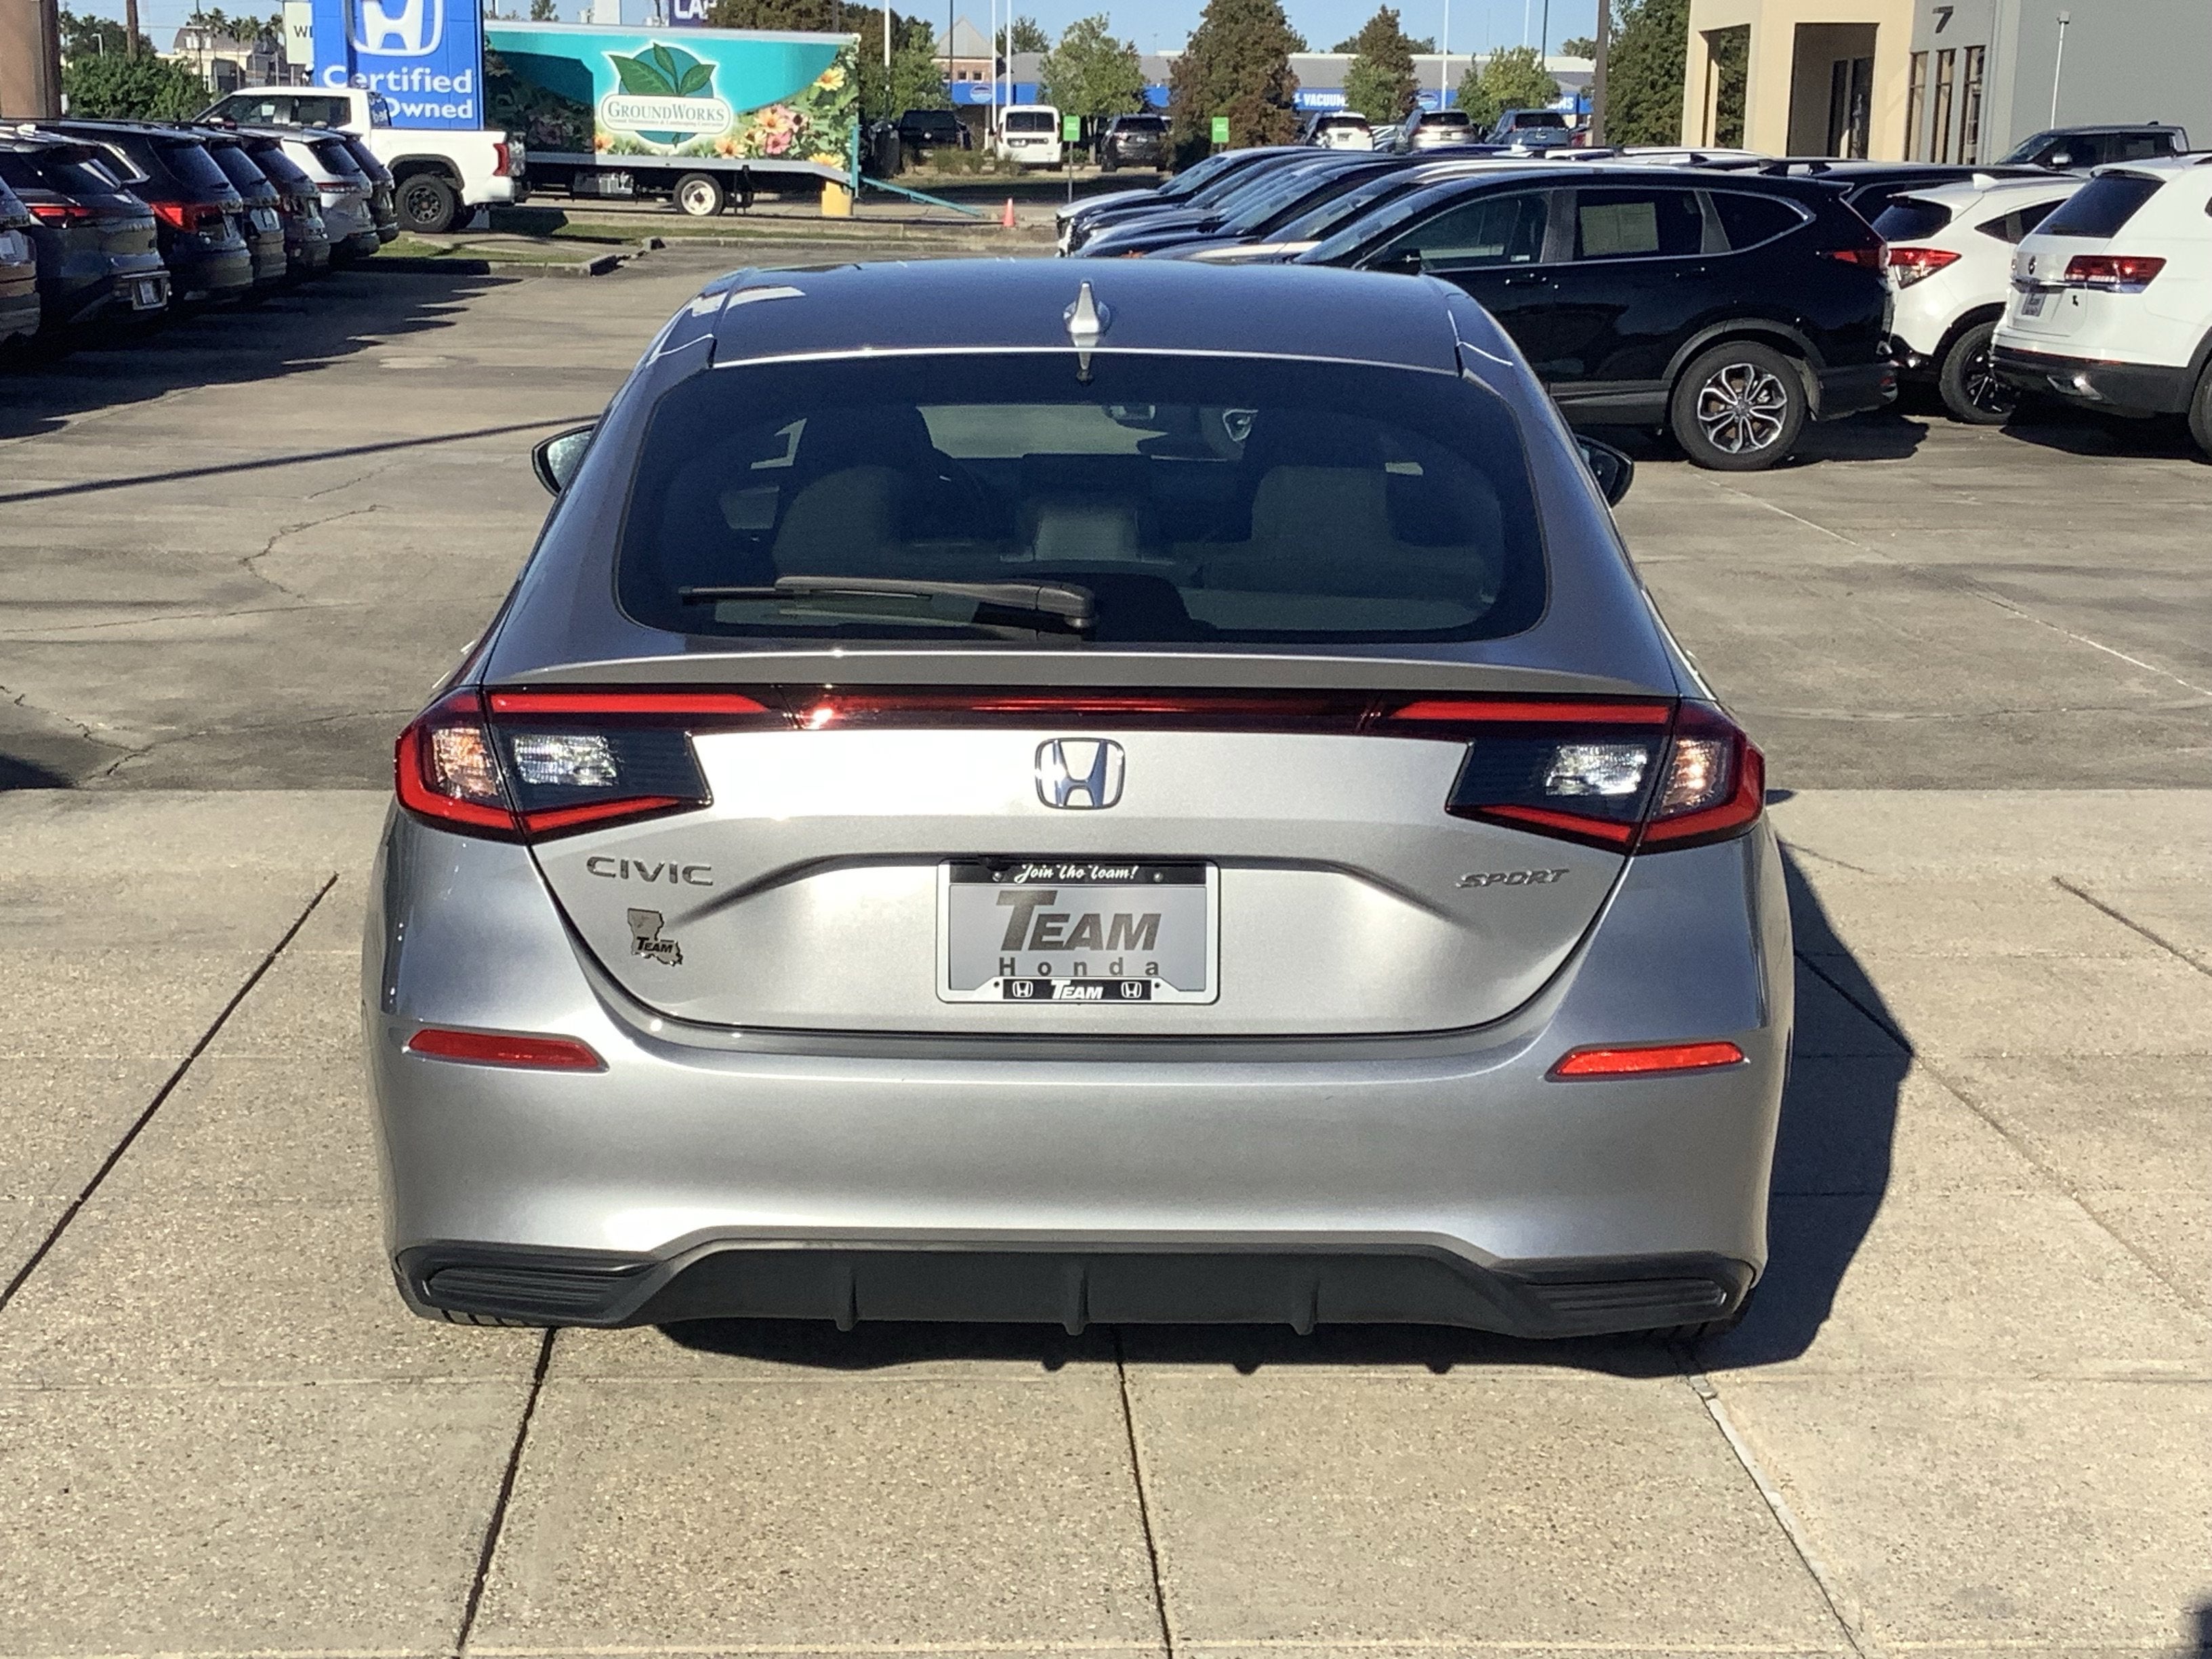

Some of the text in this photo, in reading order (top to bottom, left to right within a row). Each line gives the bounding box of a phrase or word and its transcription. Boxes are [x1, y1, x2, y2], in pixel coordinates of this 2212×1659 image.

[1932, 5, 1954, 34] 7
[323, 65, 473, 94] Certified
[1303, 93, 1349, 106] VACUUM
[586, 856, 714, 886] CIVIC
[1013, 864, 1139, 884] Join the team!
[1455, 868, 1570, 889] SPORT
[996, 890, 1162, 951] TEAM
[636, 936, 674, 954] TEAM
[999, 957, 1159, 977] Honda
[1050, 979, 1104, 1000] TEAM
